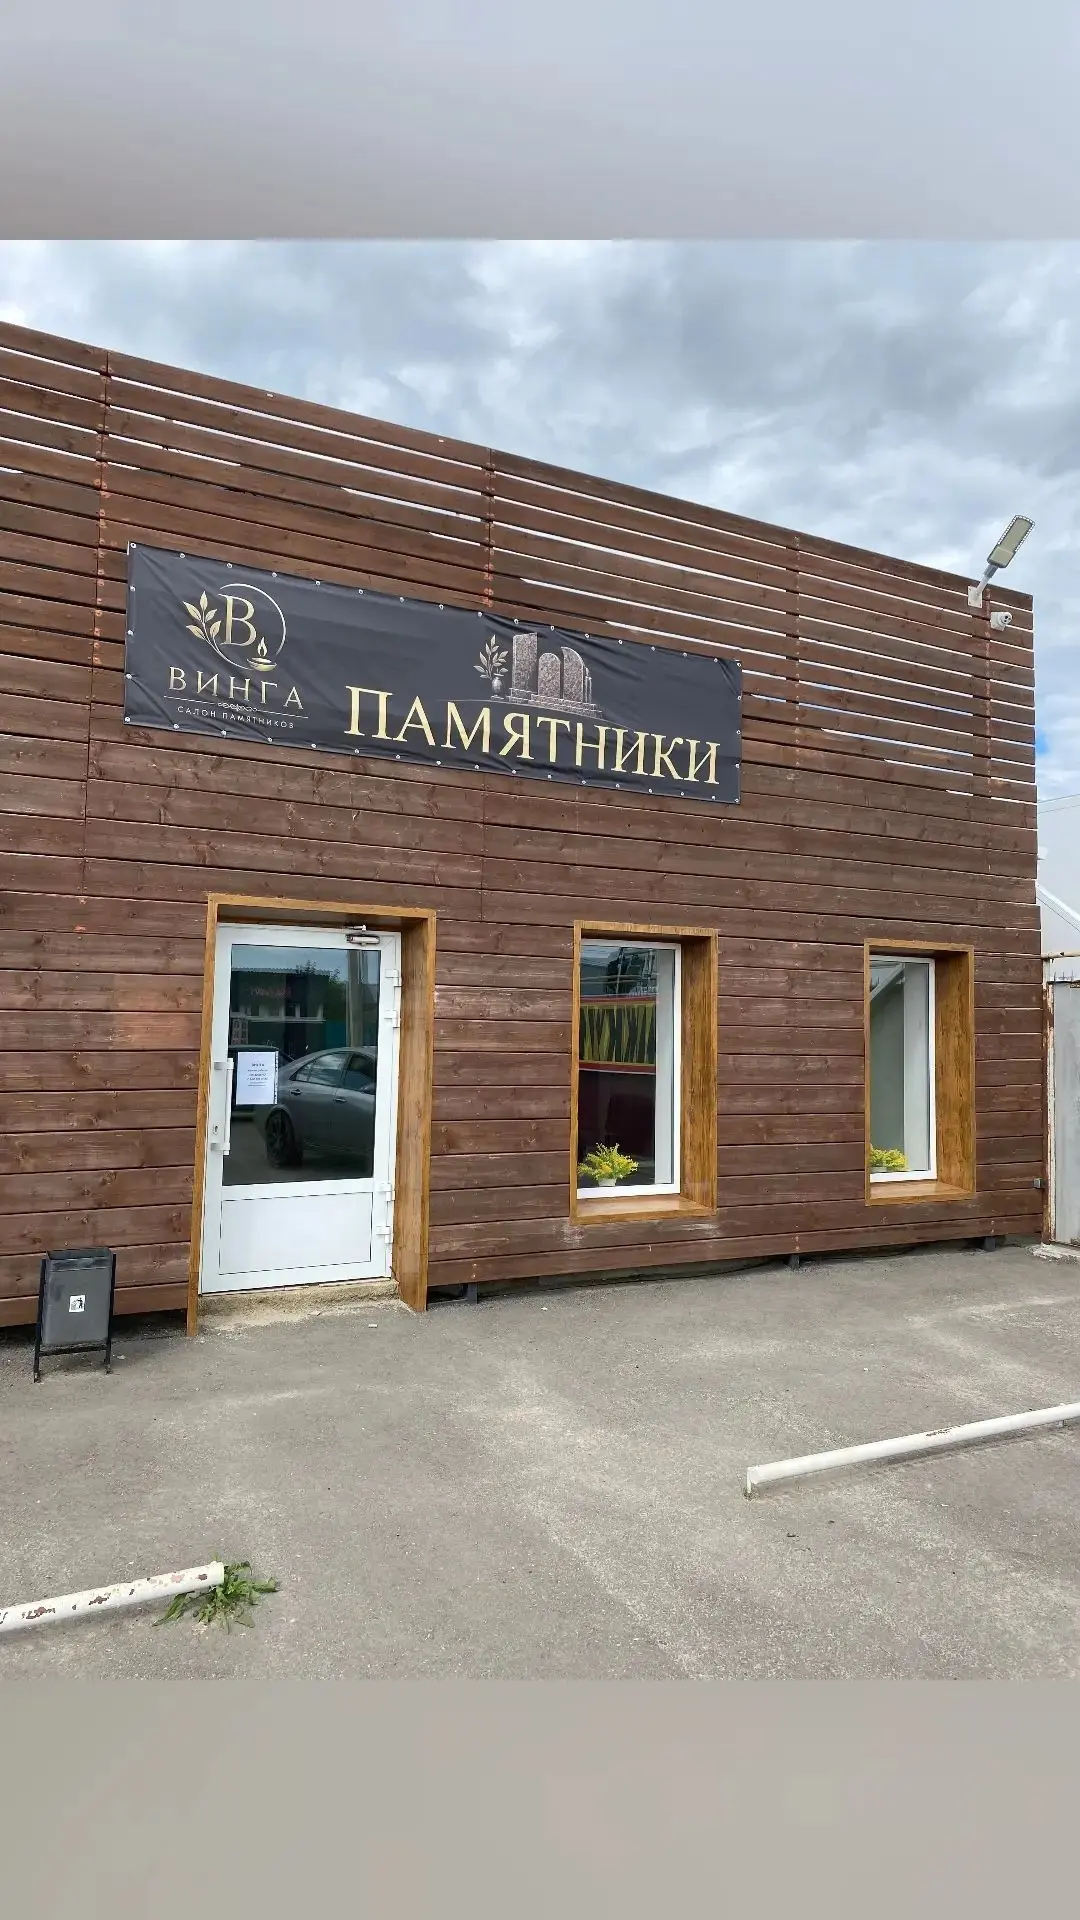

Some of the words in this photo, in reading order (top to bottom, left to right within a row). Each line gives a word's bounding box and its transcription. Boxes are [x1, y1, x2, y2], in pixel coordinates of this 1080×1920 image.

[169, 667, 304, 710] ВИНГА
[177, 706, 216, 718] САЛОН
[344, 685, 721, 784] ПАМЯТНИКИ
